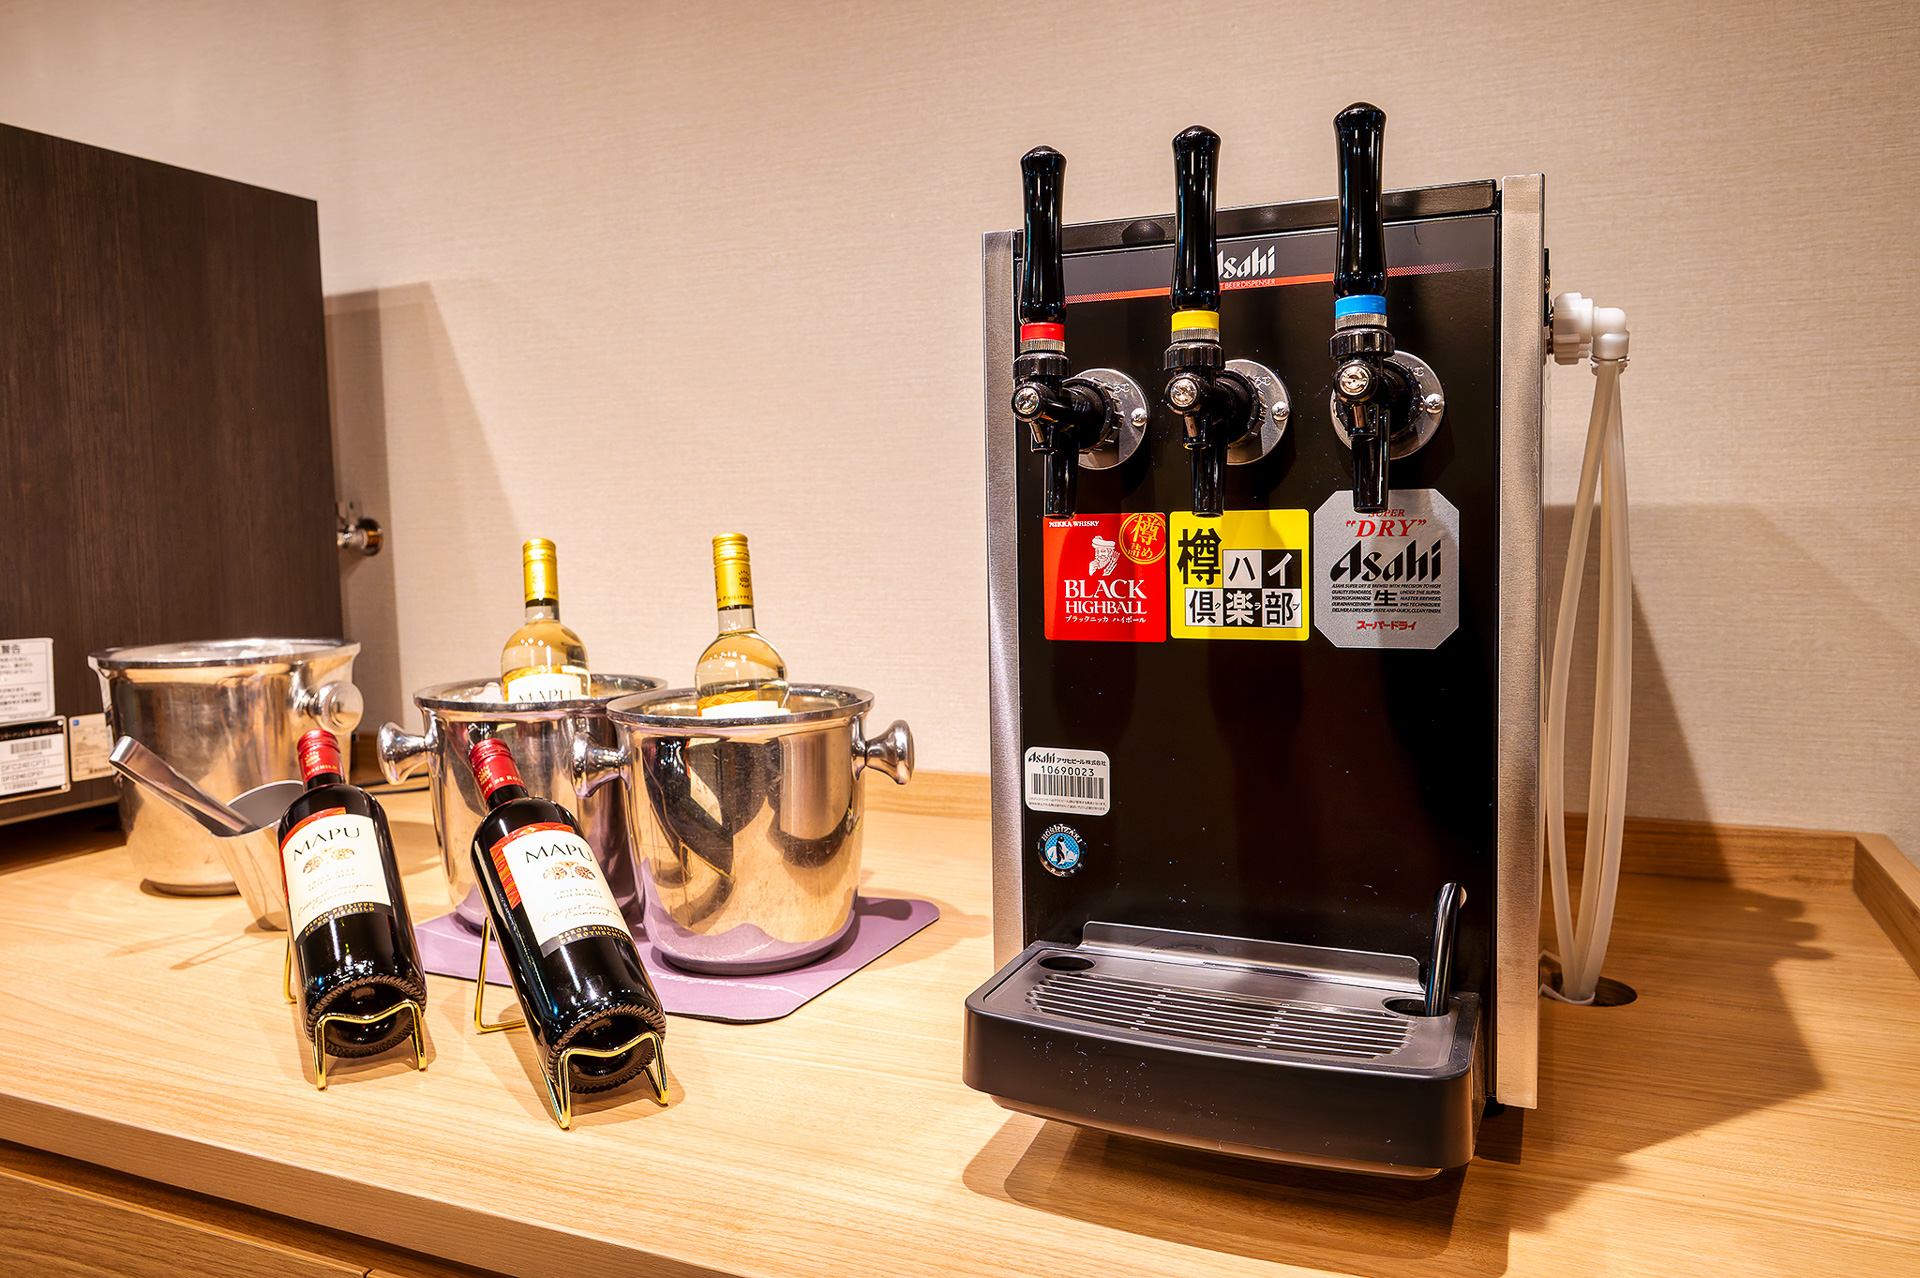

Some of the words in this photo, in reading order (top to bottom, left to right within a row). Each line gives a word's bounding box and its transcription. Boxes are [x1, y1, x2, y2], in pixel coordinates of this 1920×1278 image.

[1330, 539, 1441, 582] Asahi
[1064, 579, 1147, 599] BLACK
[1374, 590, 1398, 606] 生
[1065, 601, 1147, 614] HIGHBALL
[1065, 615, 1109, 623] ブラックニッカ
[1113, 616, 1147, 624] ハイボール
[1357, 621, 1416, 630] スーパードライ
[1028, 751, 1055, 763] Asahi
[1056, 757, 1107, 767] アサヒビール株式会社
[1041, 765, 1095, 777] 10690023
[293, 827, 360, 862] MAPU
[525, 844, 593, 864] MAPU
